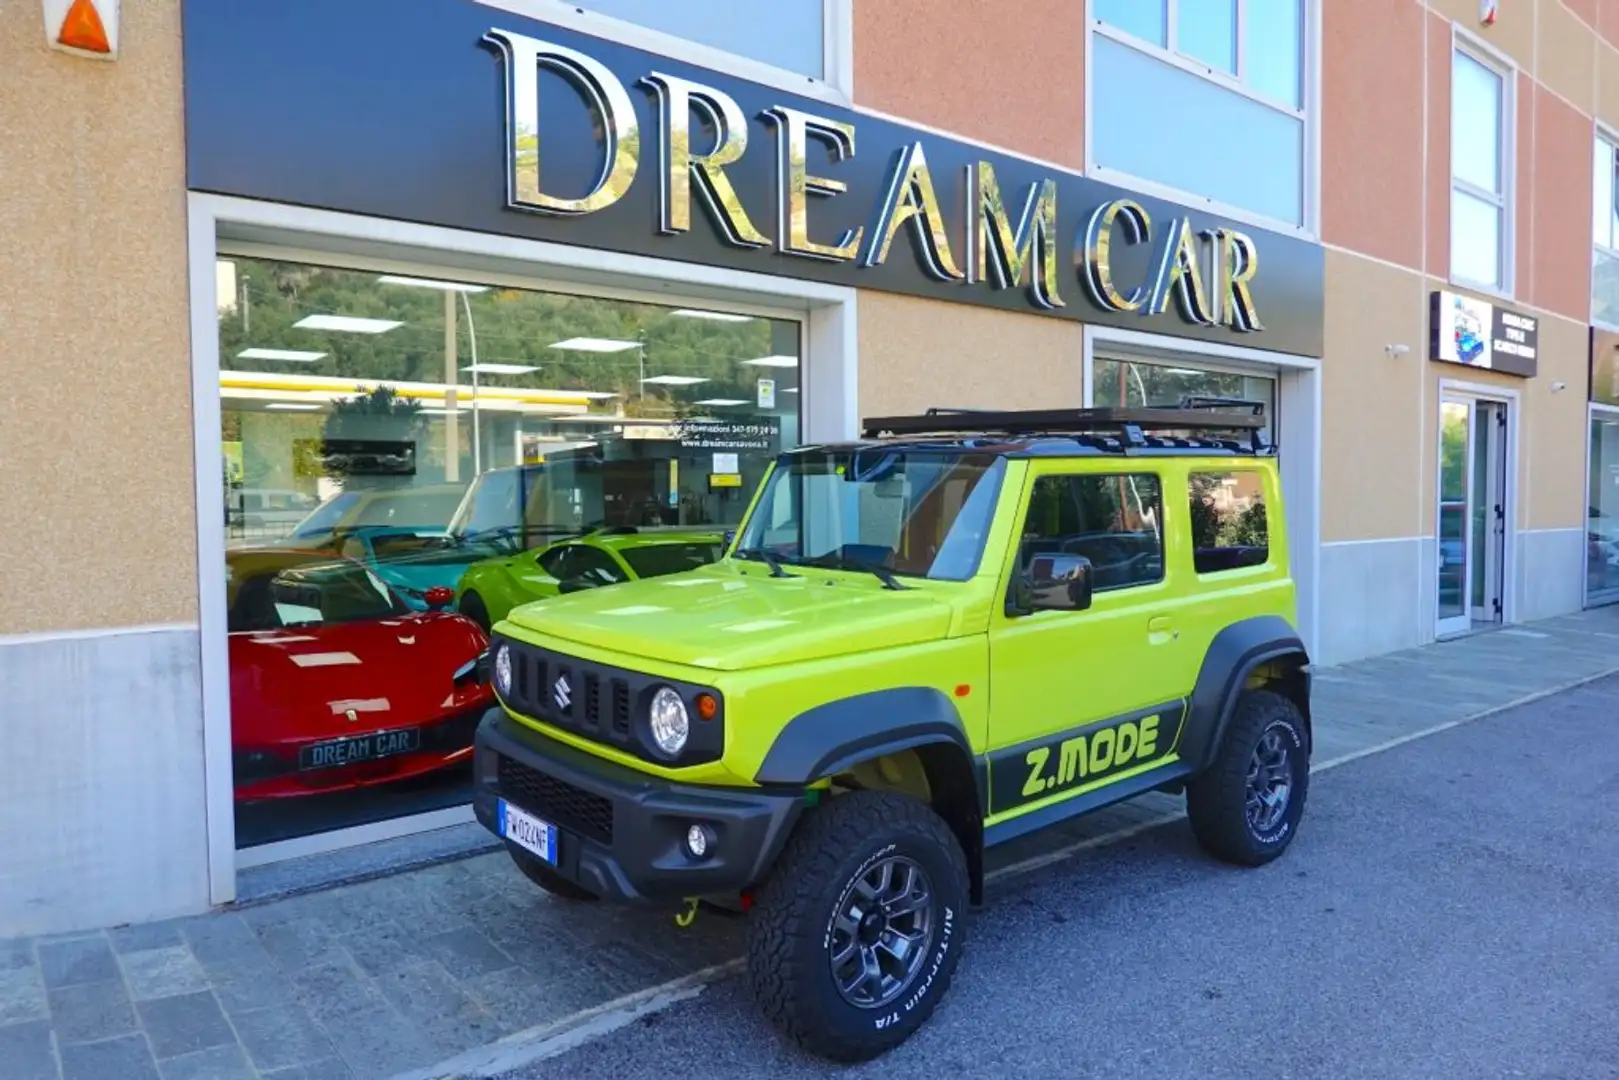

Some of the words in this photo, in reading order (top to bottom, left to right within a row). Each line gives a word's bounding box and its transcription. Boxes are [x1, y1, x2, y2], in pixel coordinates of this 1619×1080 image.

[483, 26, 1064, 309] DREAM
[1074, 198, 1264, 331] CAR
[312, 738, 370, 765] DREAM
[376, 731, 410, 753] CAR
[1021, 714, 1160, 796] Z.MODE
[905, 907, 954, 1011] All-Terrain
[874, 1011, 901, 1029] T/A
